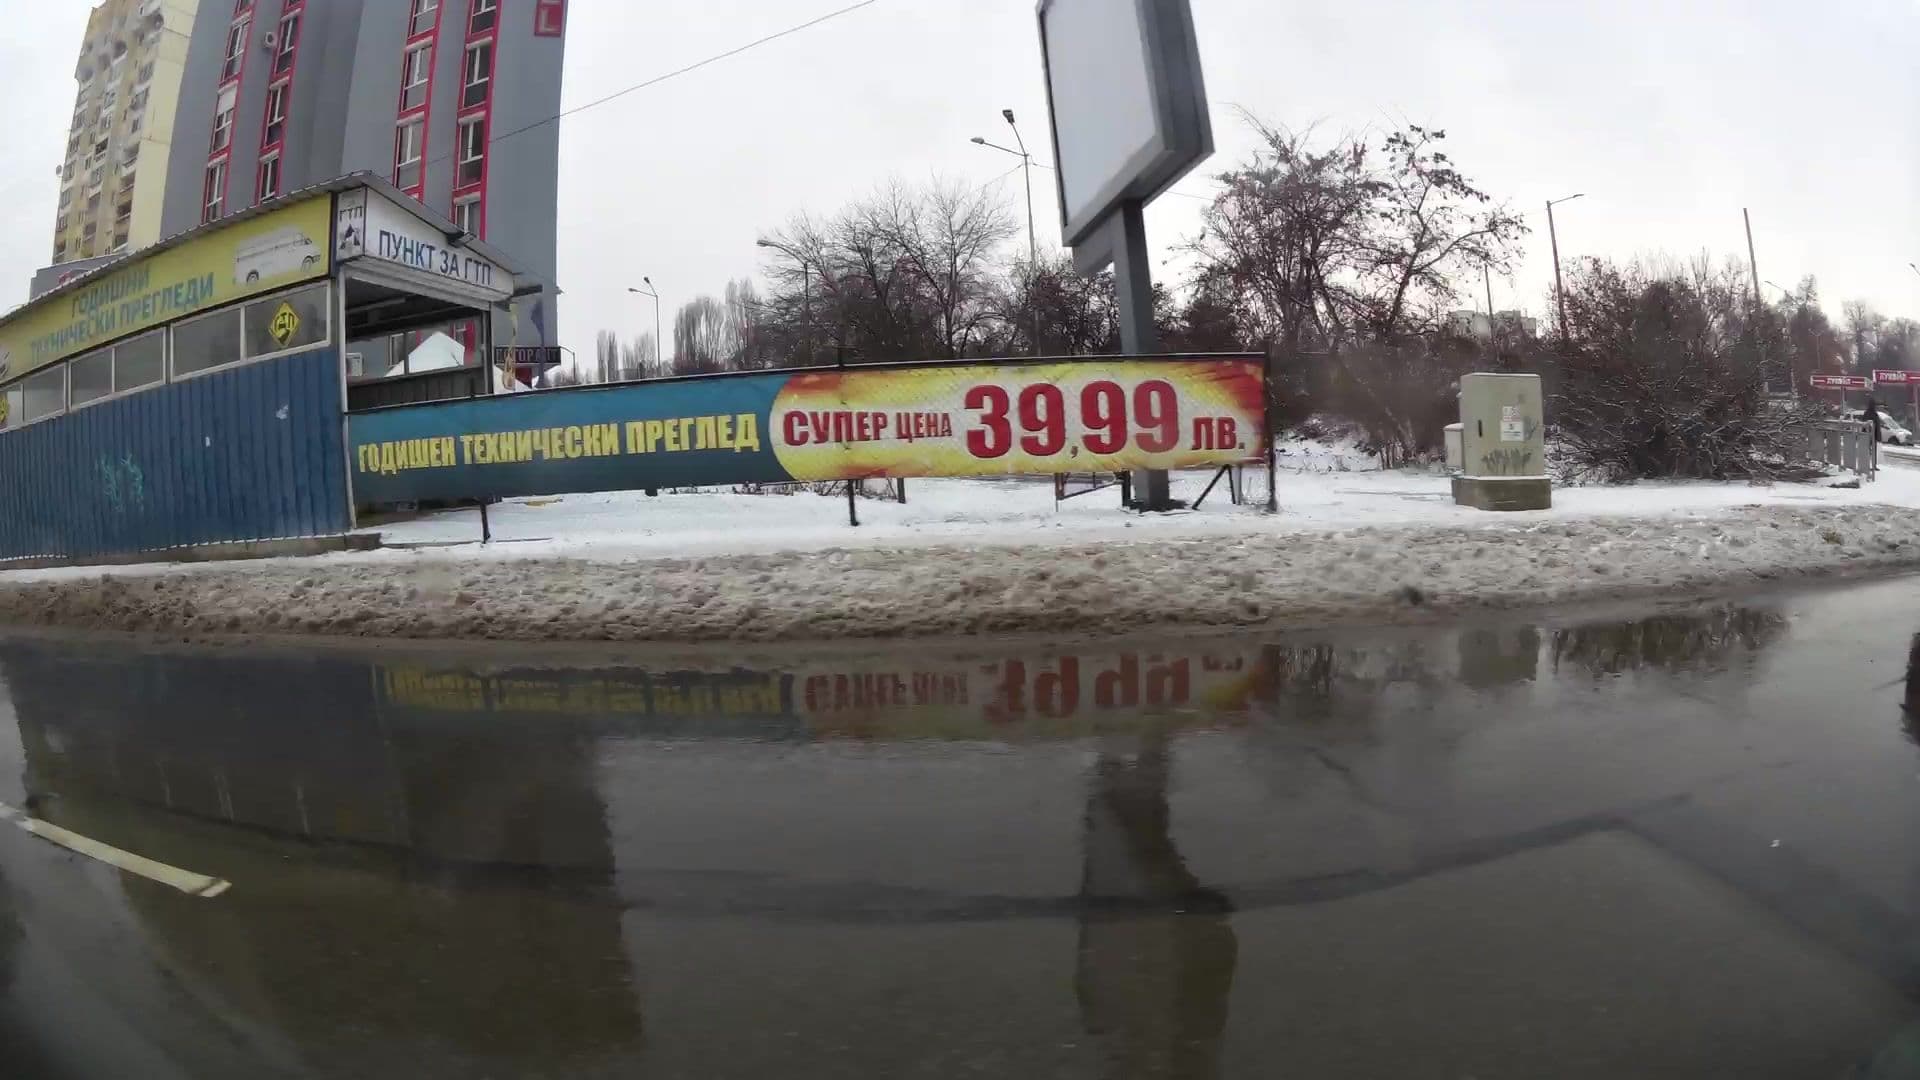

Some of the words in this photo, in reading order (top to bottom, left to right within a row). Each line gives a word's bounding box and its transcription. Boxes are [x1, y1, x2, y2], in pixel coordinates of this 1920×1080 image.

[339, 206, 363, 222] ГТП
[379, 230, 436, 269] ПУНКТ
[440, 249, 460, 277] ЗА
[464, 257, 491, 285] ГТП
[120, 272, 214, 327] ПРЕГЛЕДИ
[358, 436, 456, 475] ГОДИШЕН
[460, 423, 619, 465] ТЕХНИЧЕСКИ
[625, 413, 760, 454] ПРЕГЛЕД
[783, 411, 887, 447] СУПЕР
[895, 412, 952, 443] ЦЕНА
[963, 380, 1179, 459] 39,99
